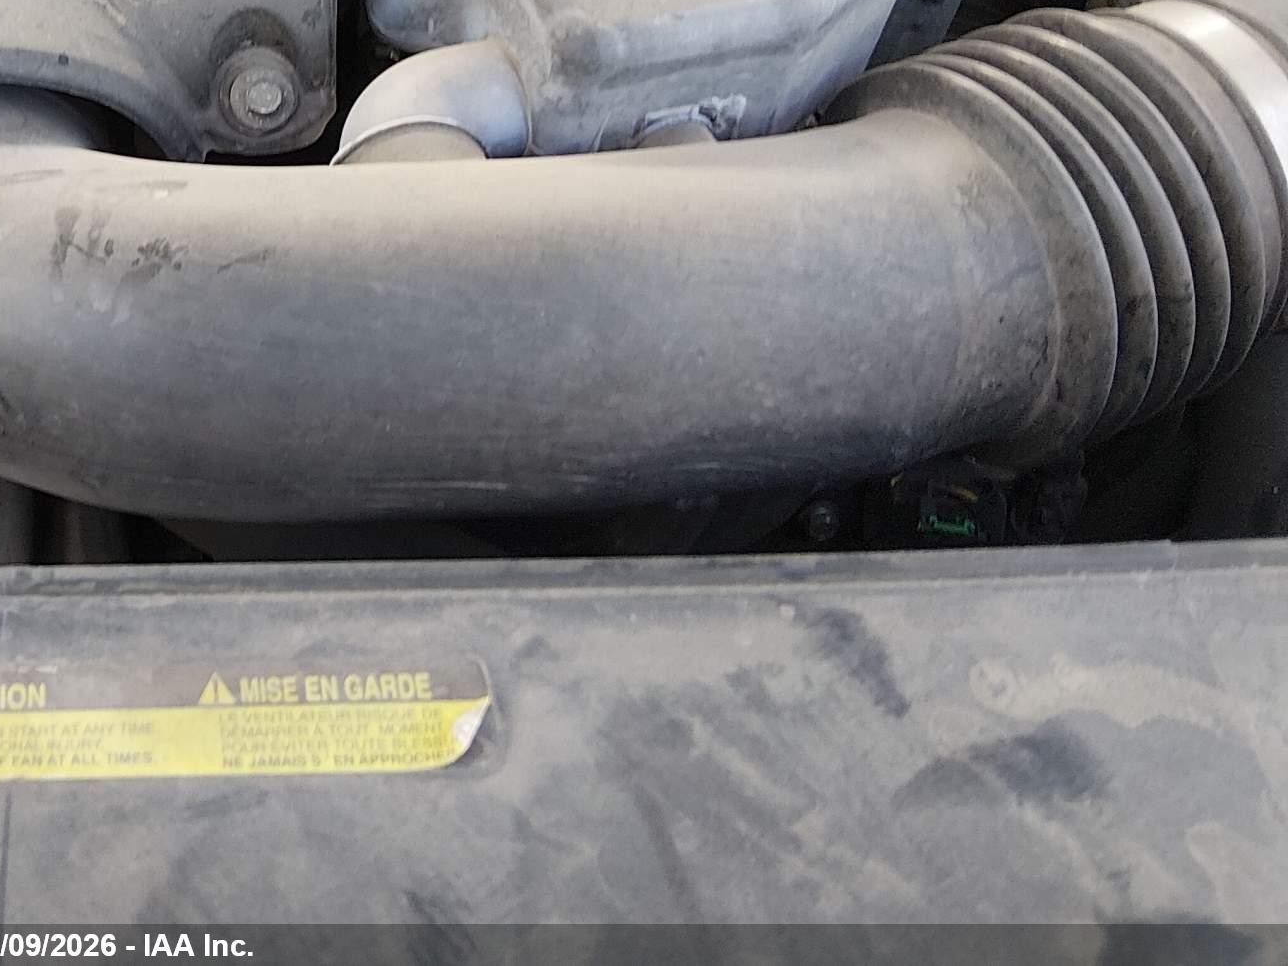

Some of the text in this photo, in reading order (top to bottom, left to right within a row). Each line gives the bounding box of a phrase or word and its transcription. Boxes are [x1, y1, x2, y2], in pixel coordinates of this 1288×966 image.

[240, 672, 433, 703] MISE EN GARDE
[11, 754, 43, 767] FAN
[47, 753, 65, 766] AT
[71, 752, 99, 766] ALL
[222, 755, 242, 769] NE
[248, 754, 306, 768] JAMAIS
[333, 753, 355, 766] EN
